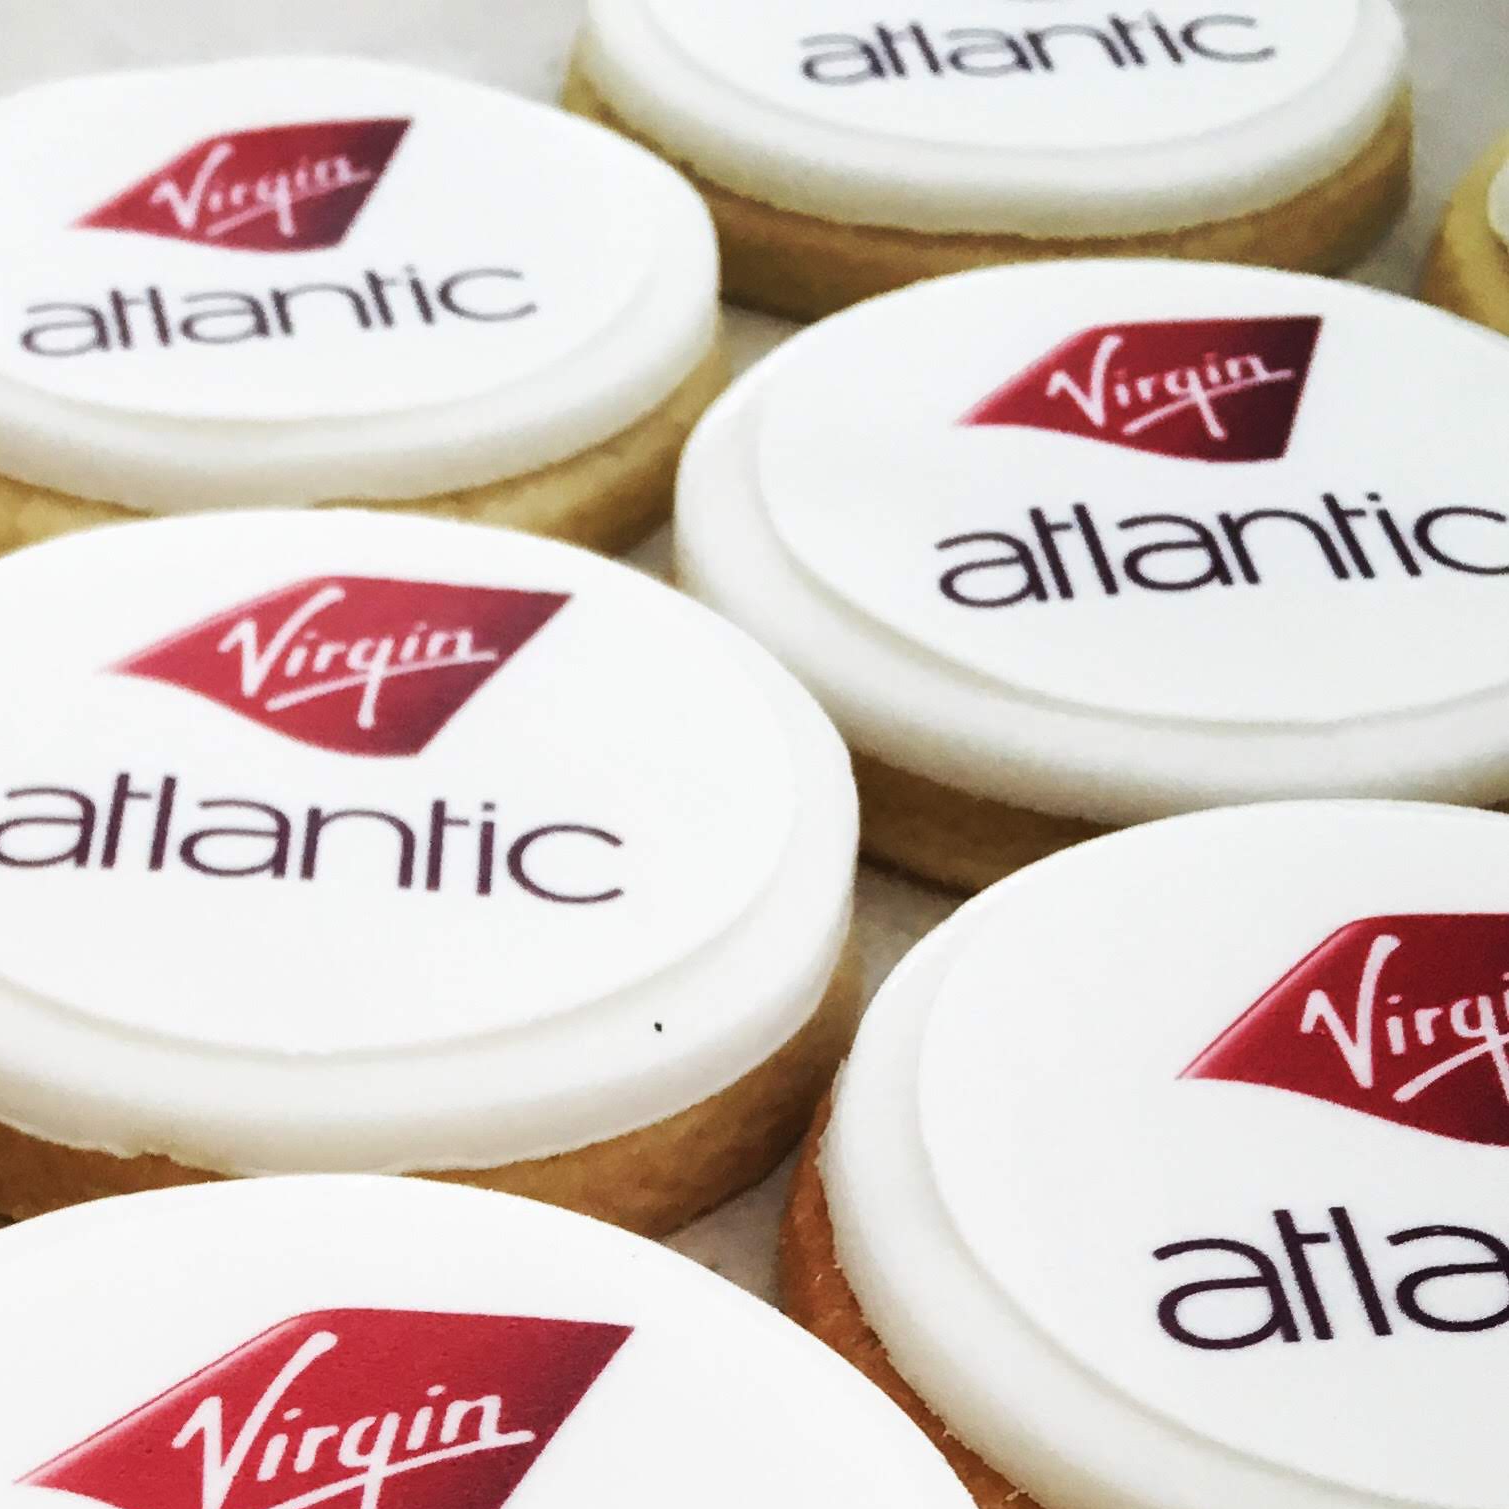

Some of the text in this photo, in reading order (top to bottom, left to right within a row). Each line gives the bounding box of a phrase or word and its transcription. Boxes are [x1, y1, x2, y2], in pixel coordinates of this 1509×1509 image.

[799, 12, 1276, 85] atlantic
[151, 142, 371, 238] Virgin
[20, 265, 538, 357] atlantic
[1045, 334, 1292, 438] Virgin
[933, 491, 1509, 610] atlantic
[217, 587, 499, 731] Virgin
